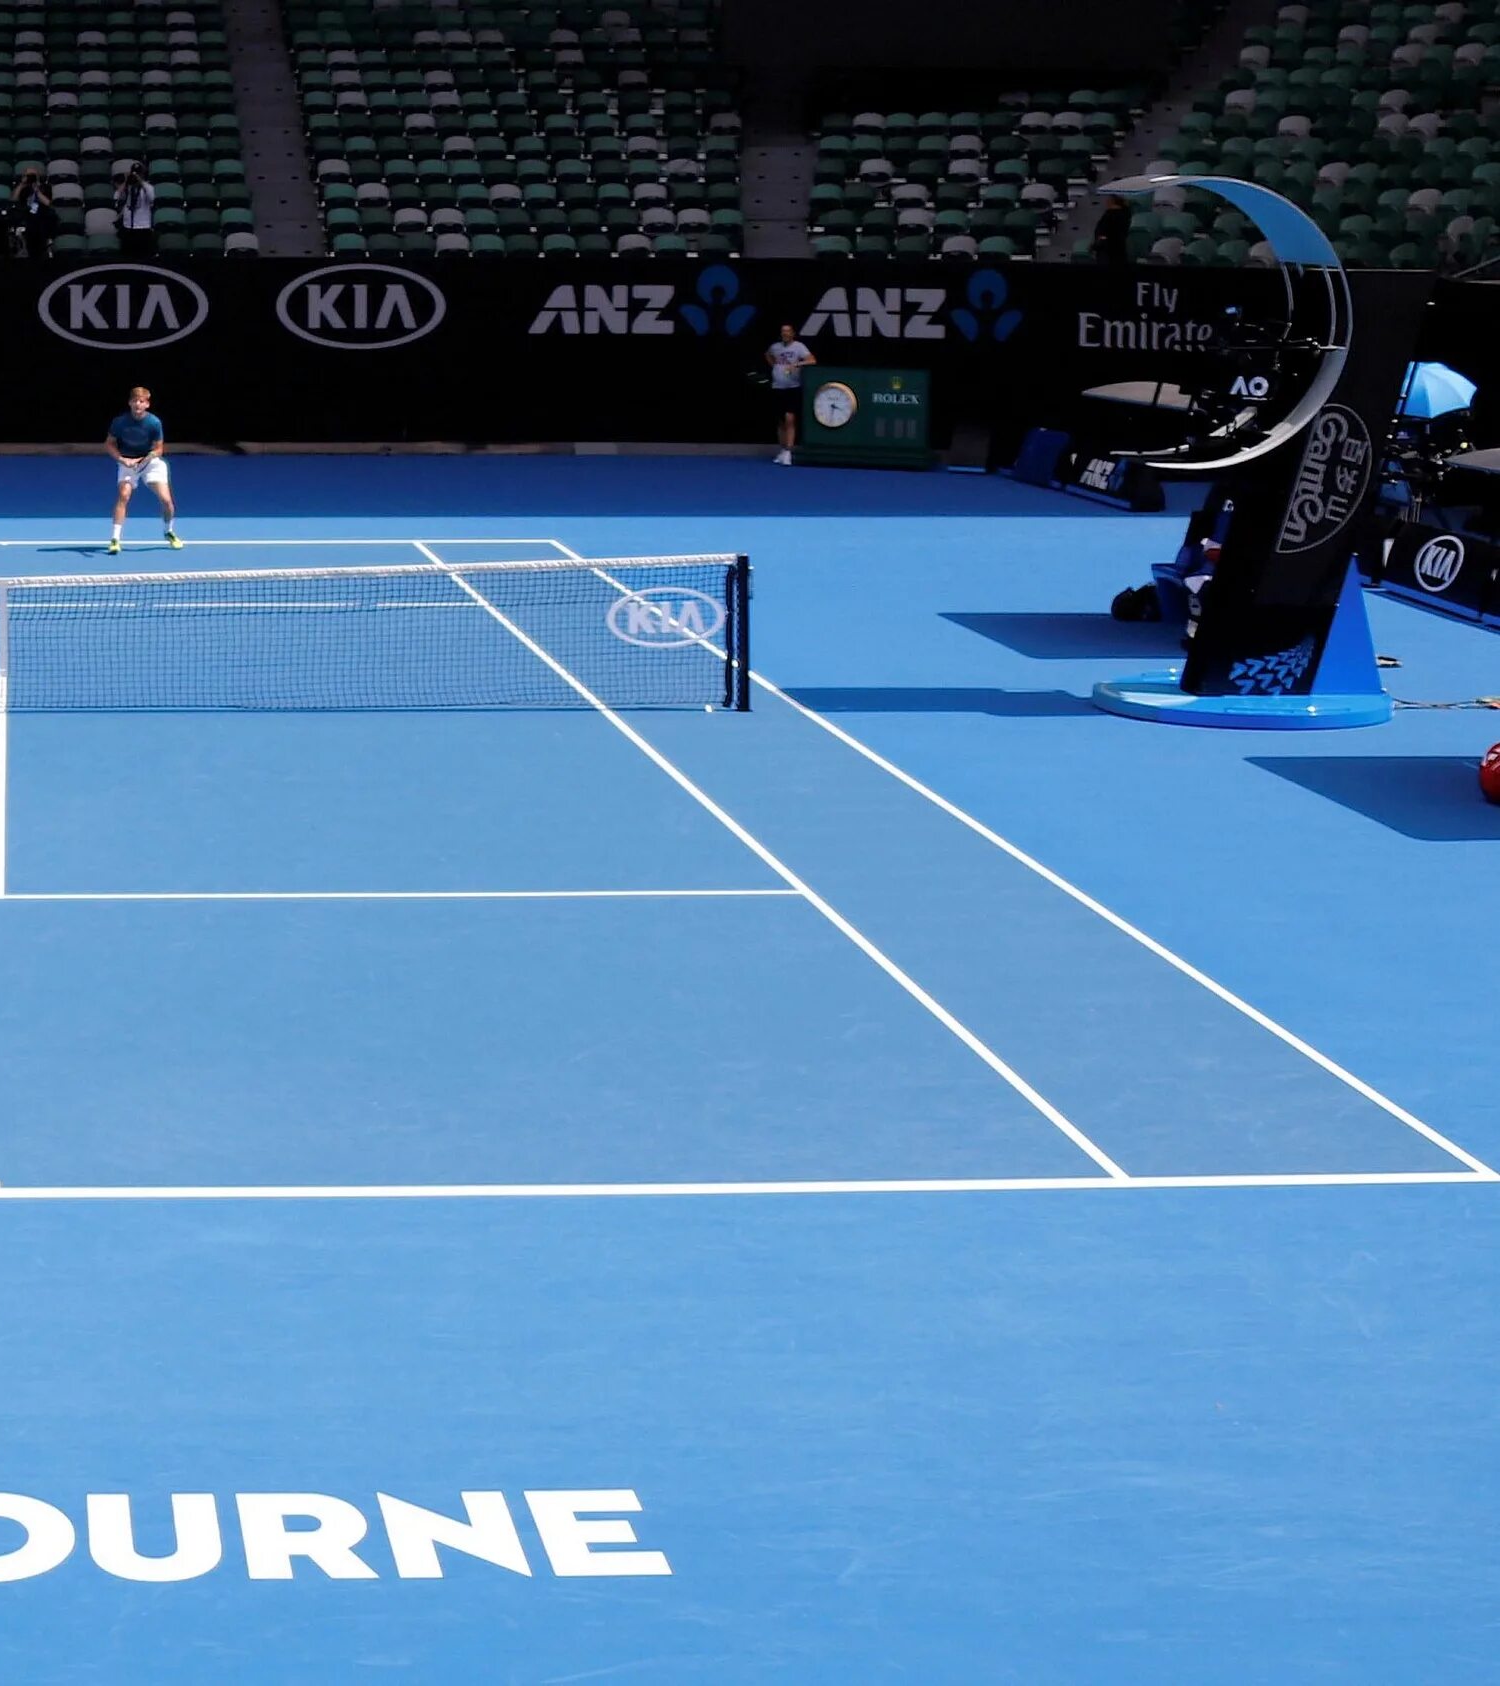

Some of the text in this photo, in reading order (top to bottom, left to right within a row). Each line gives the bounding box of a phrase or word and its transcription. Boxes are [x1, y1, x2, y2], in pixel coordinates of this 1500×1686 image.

[68, 283, 181, 330] KIA
[306, 283, 418, 330] KIA
[528, 284, 675, 335] ANZ
[799, 286, 947, 340] ANZ
[1137, 281, 1178, 313] Fly
[1077, 311, 1214, 352] Emirate
[872, 393, 920, 404] ROLEX
[1229, 375, 1269, 397] AO
[1420, 544, 1457, 583] KIA
[625, 600, 706, 635] KIA
